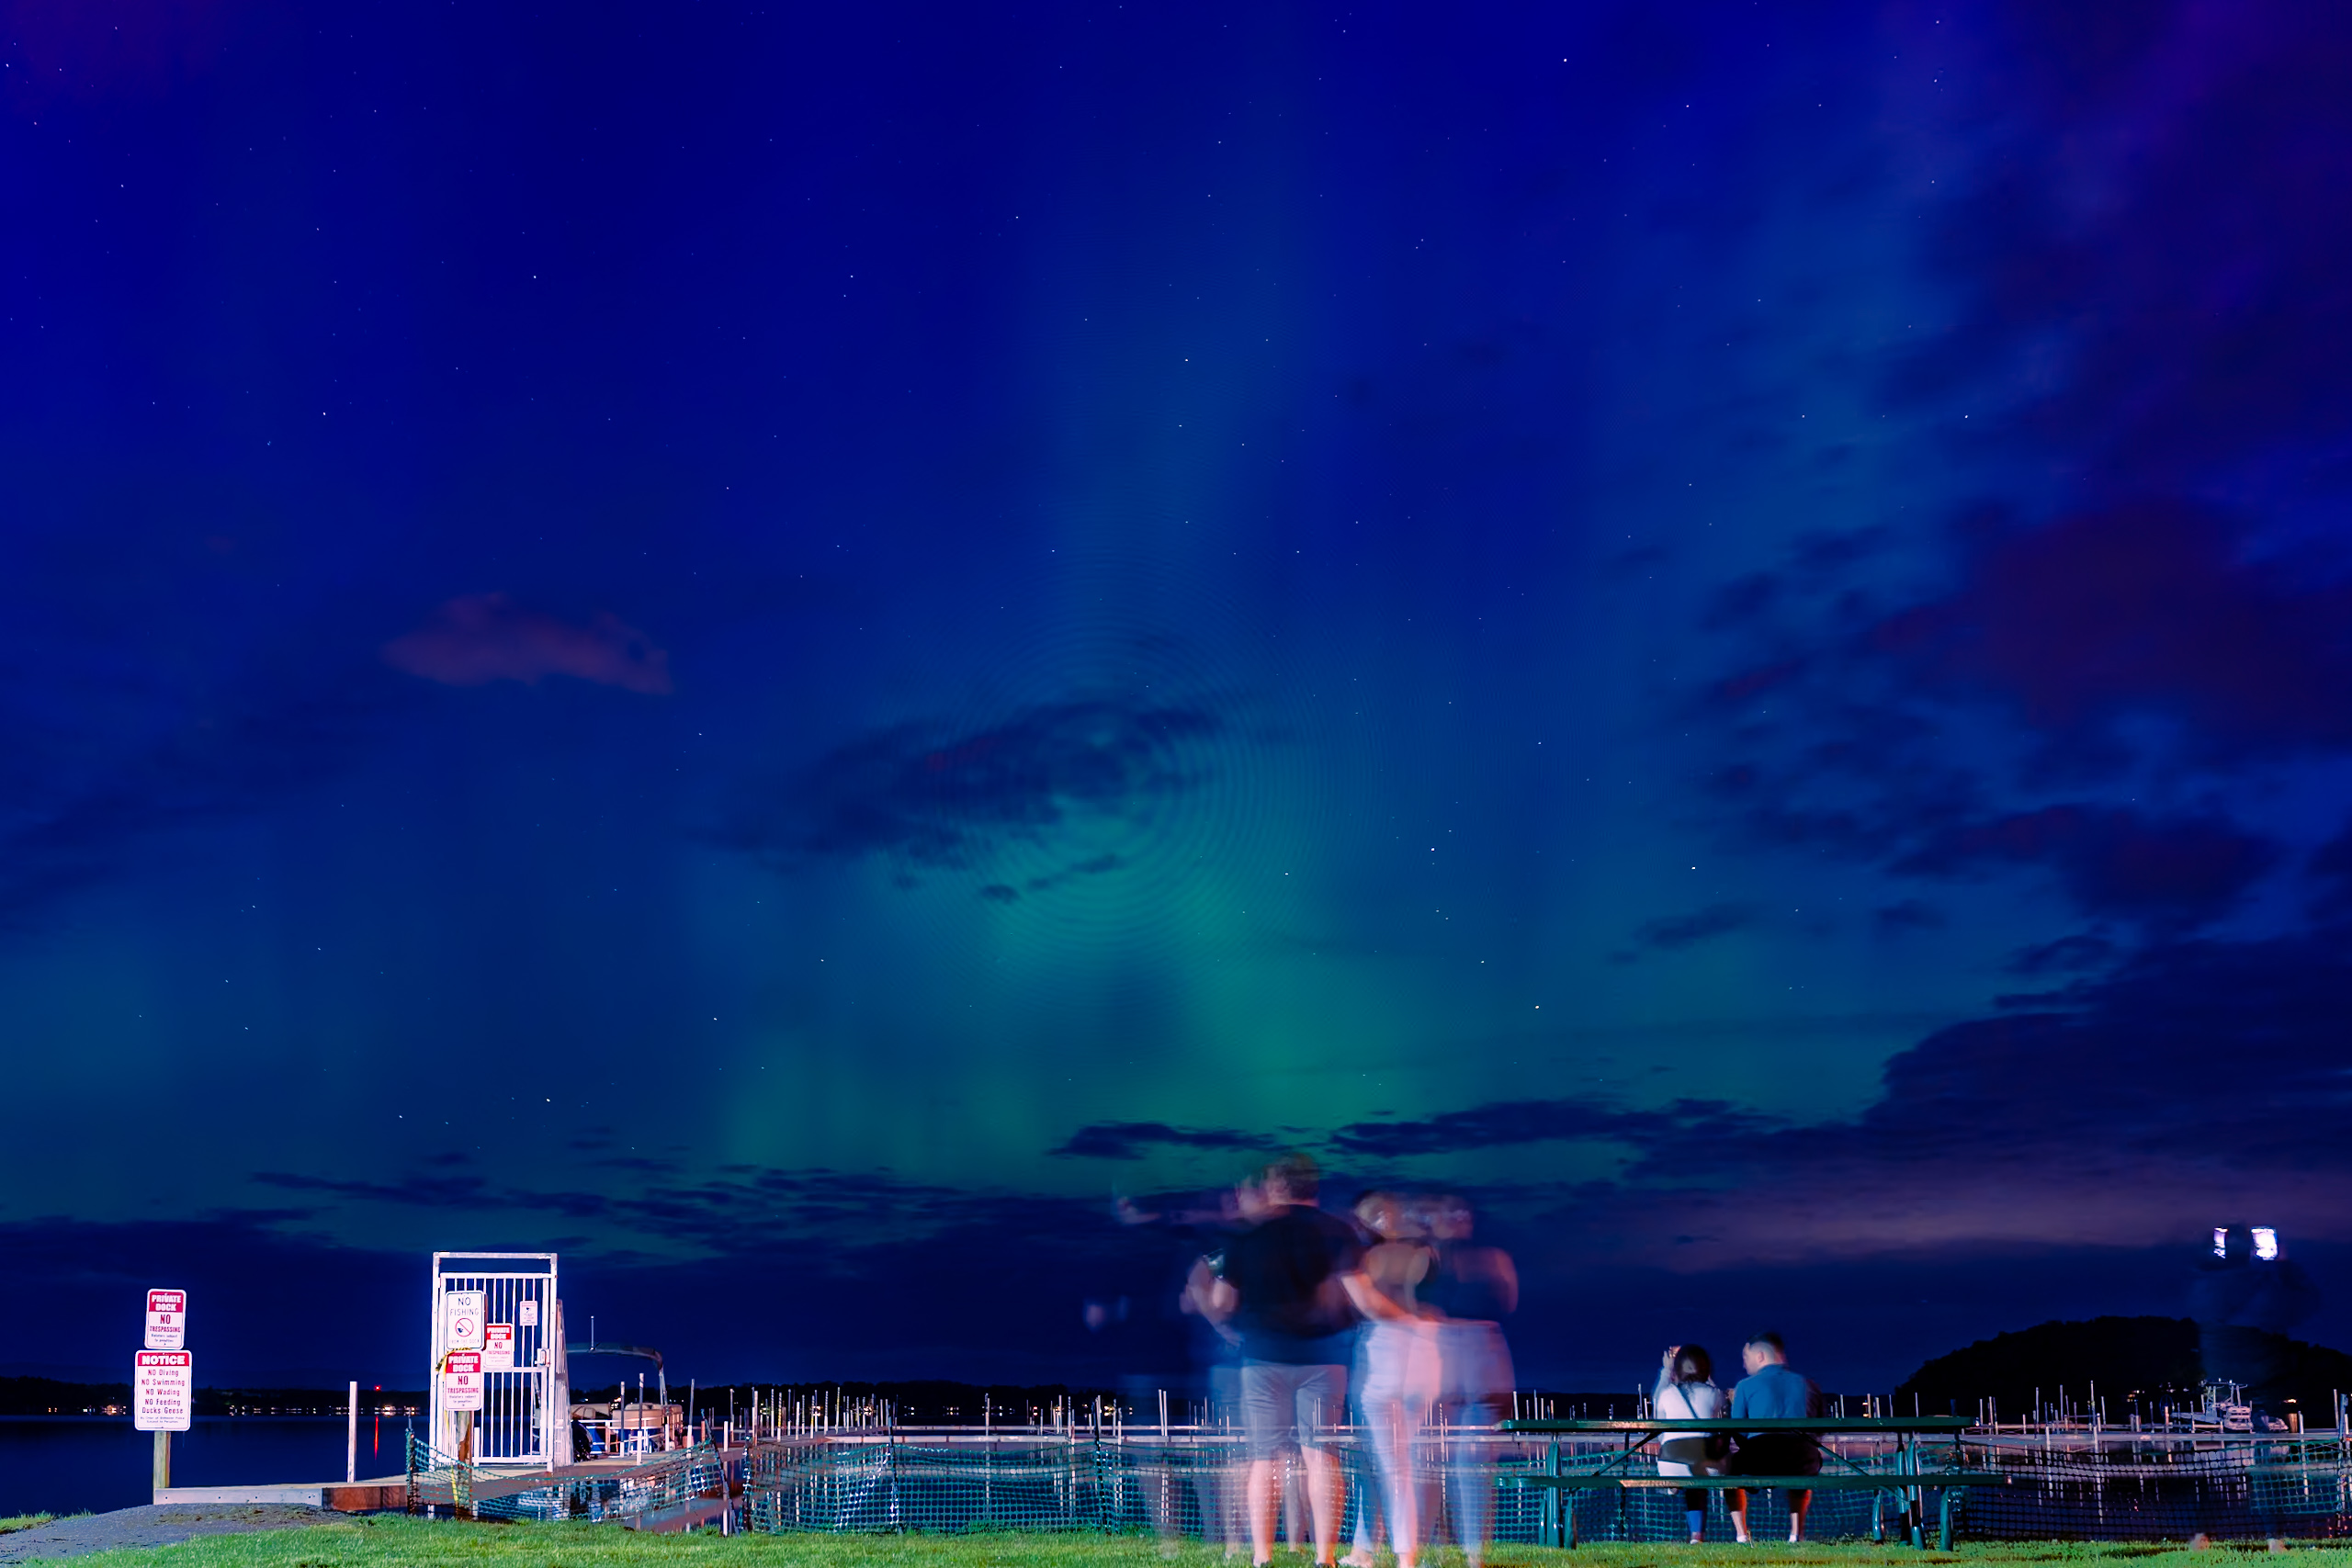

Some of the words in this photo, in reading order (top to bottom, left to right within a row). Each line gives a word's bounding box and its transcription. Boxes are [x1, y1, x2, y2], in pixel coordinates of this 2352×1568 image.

[152, 1294, 182, 1303] PRIVATE
[458, 1296, 470, 1306] NO
[155, 1303, 177, 1312] DOCK
[449, 1308, 479, 1316] FISHING
[160, 1314, 171, 1325] NO
[493, 1341, 503, 1349] NO
[141, 1355, 186, 1365] NOTICE
[448, 1355, 479, 1364] PRIVATE
[452, 1363, 474, 1372] DOCK
[159, 1369, 179, 1378] Diving
[141, 1378, 150, 1386] NO
[152, 1378, 186, 1387] Swimming
[458, 1375, 469, 1385] NO
[145, 1388, 154, 1396] NO
[156, 1388, 180, 1397] Wading
[155, 1398, 181, 1407] Feeding
